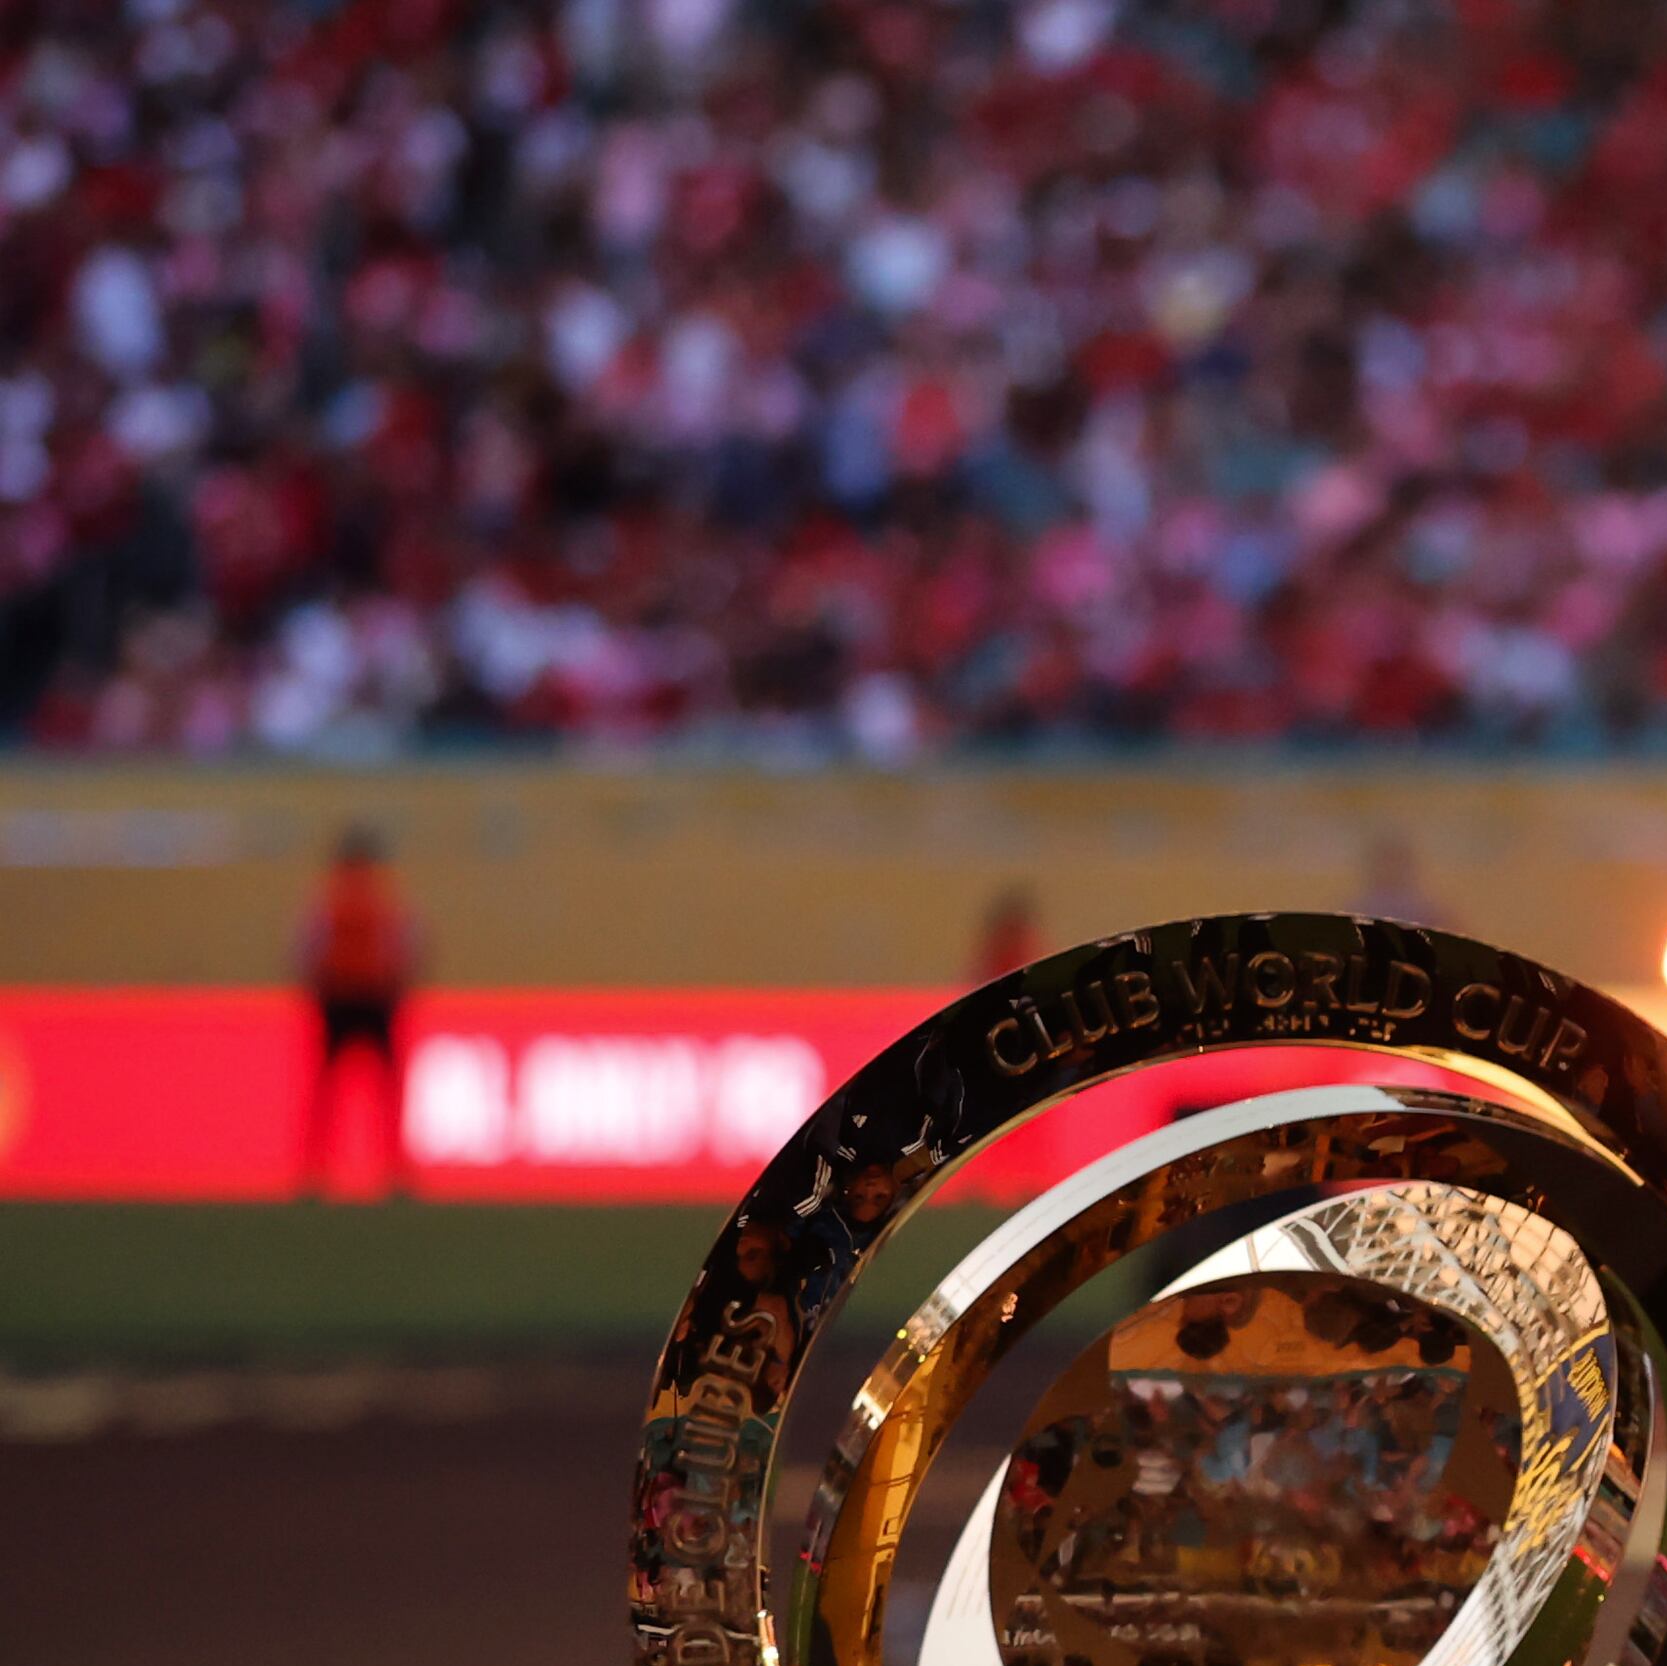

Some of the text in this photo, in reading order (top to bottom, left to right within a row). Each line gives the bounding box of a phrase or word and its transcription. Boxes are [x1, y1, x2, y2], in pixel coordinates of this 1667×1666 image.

[984, 950, 1588, 1078] CLUB WORLD CUP
[664, 1300, 778, 1564] CLUBES
